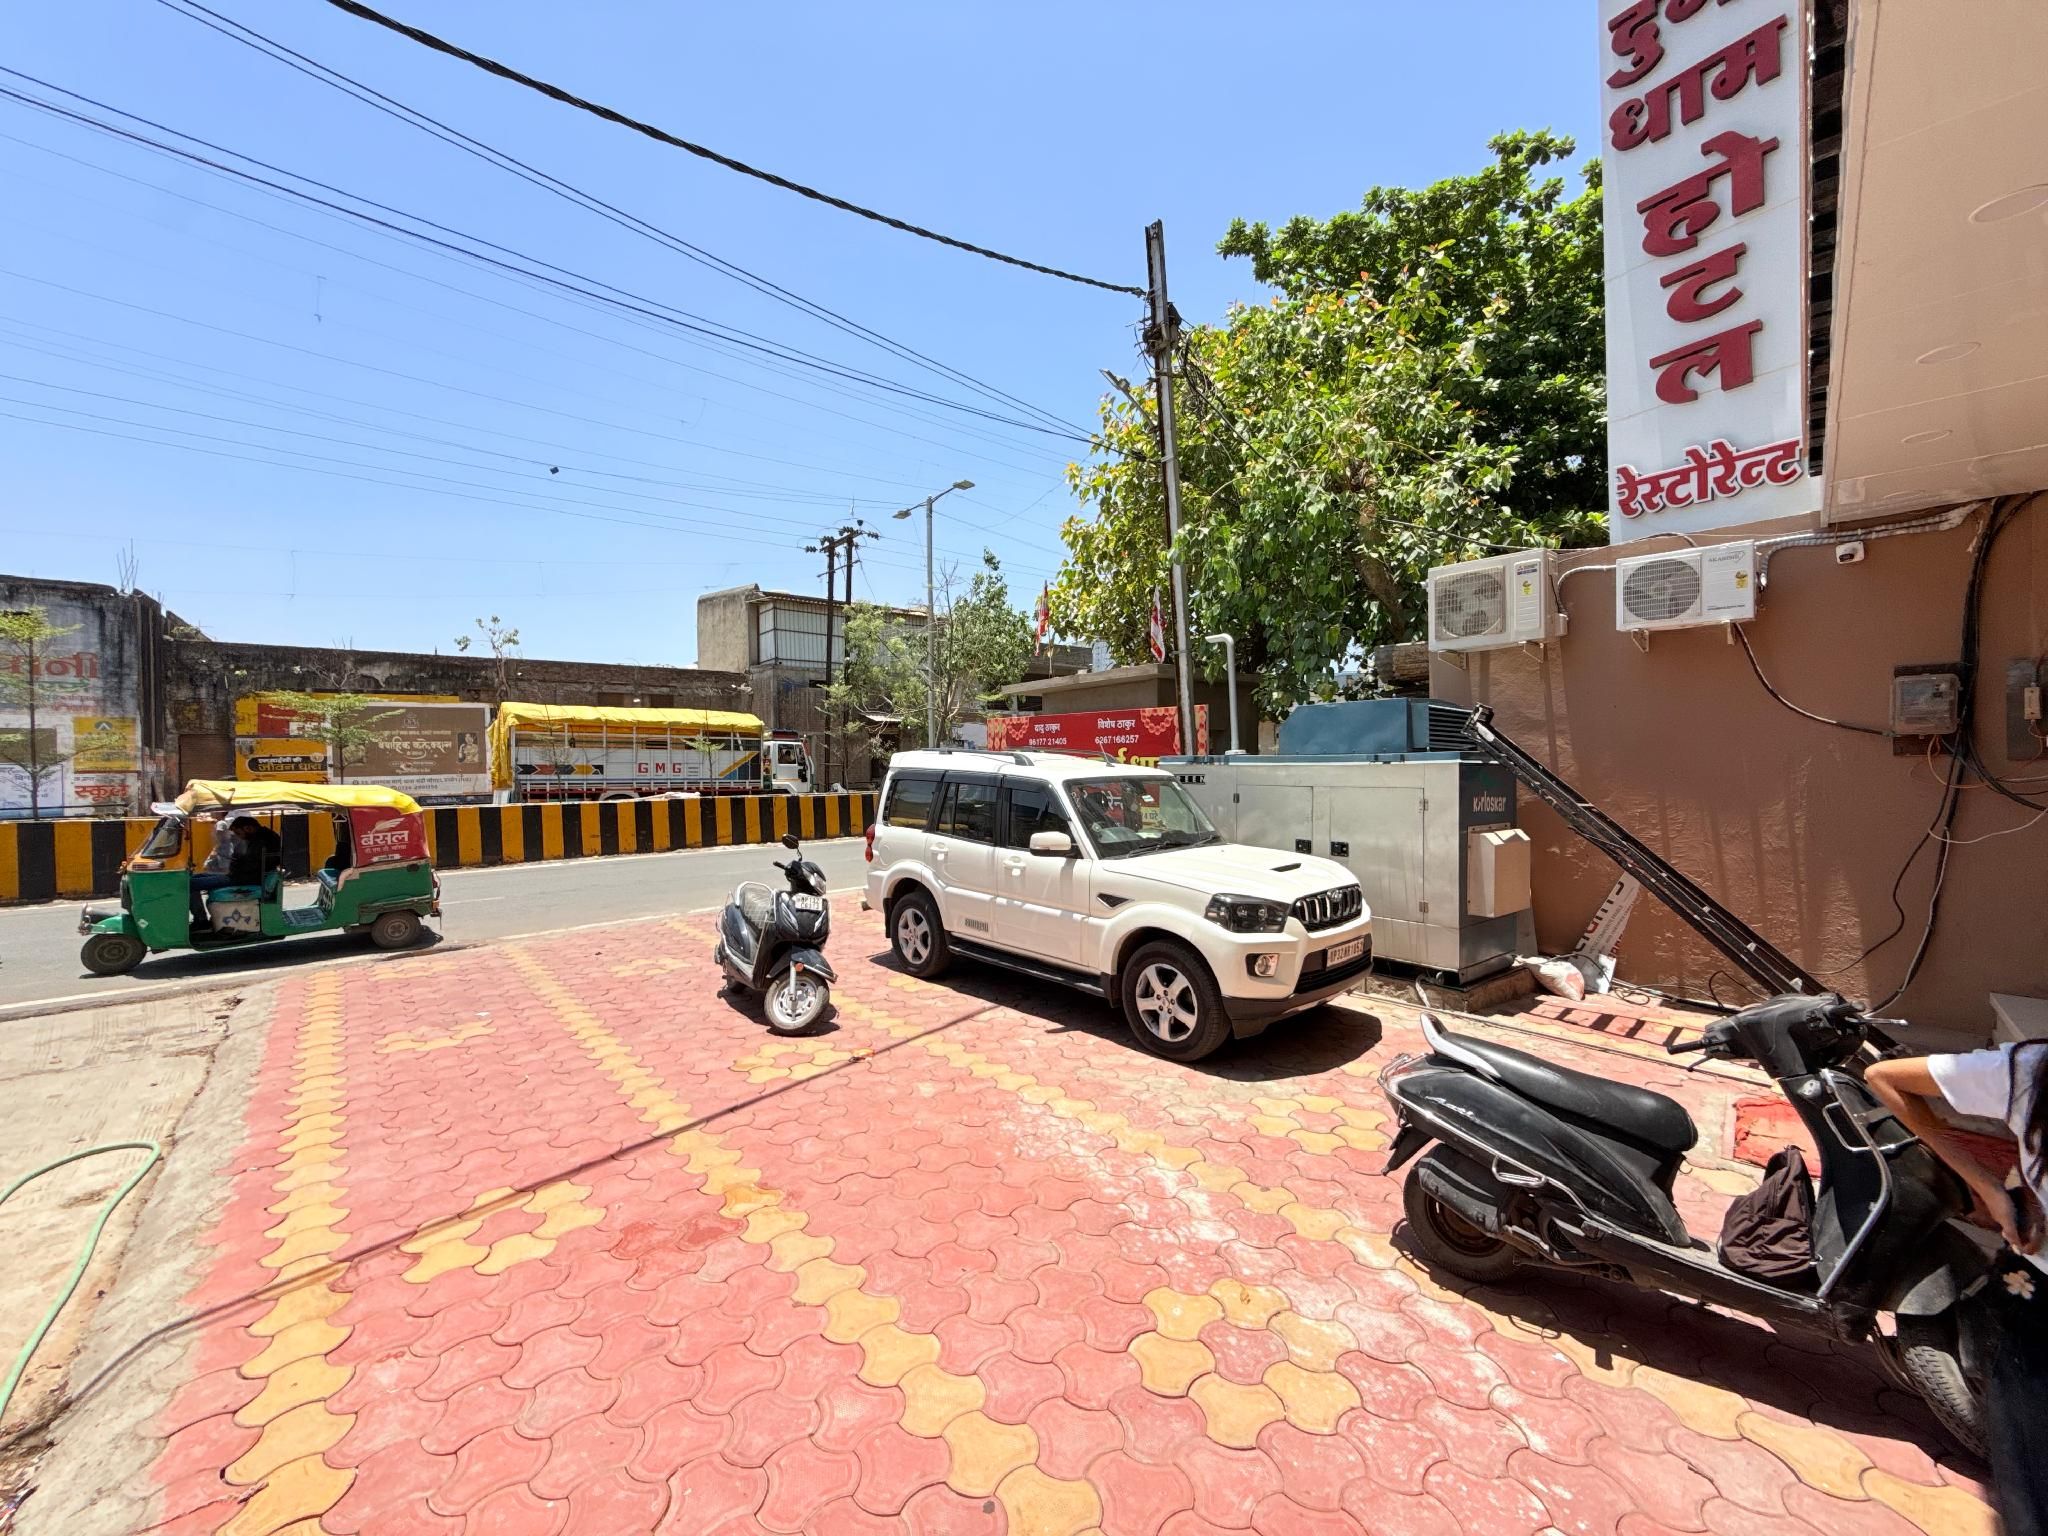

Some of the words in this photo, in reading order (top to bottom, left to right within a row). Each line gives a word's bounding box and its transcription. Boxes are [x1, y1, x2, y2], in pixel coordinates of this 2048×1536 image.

[1609, 13, 1788, 152] धाम
[1615, 437, 1803, 518] रेस्टोरेन्ट
[360, 830, 409, 846] बंसल
